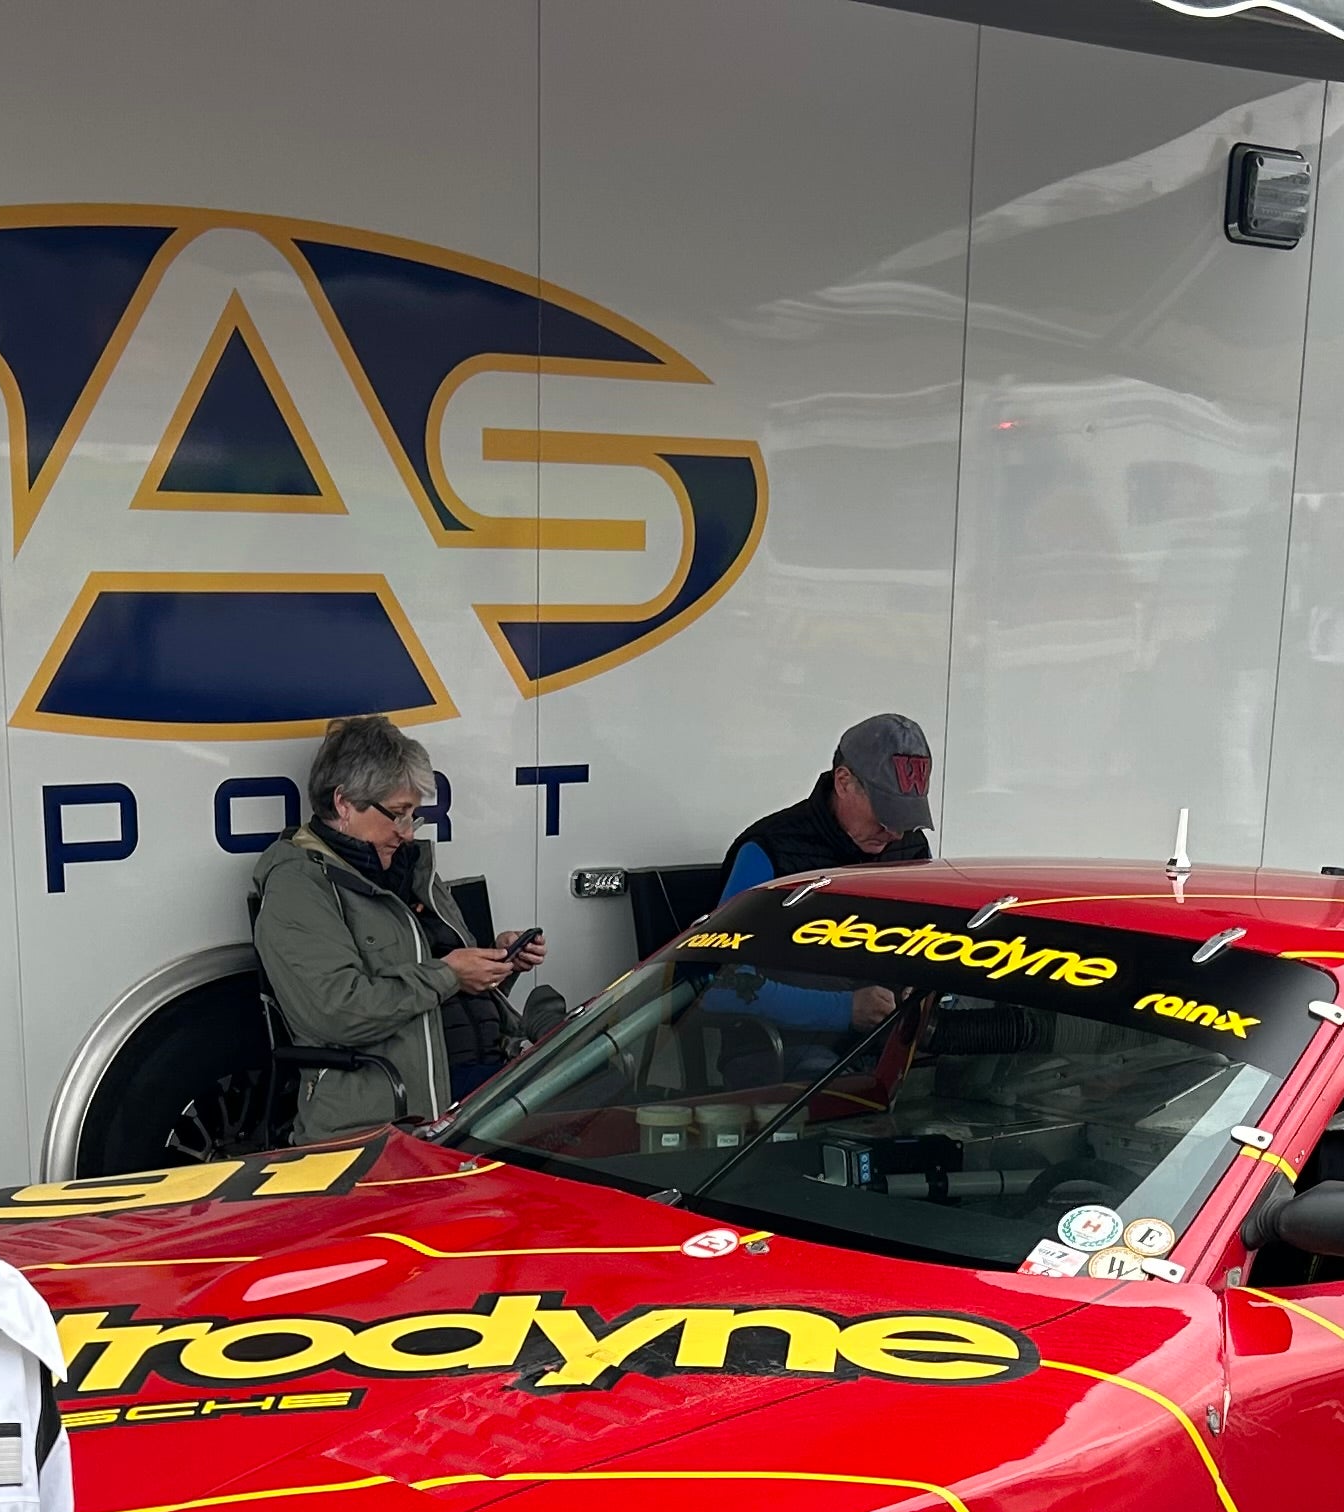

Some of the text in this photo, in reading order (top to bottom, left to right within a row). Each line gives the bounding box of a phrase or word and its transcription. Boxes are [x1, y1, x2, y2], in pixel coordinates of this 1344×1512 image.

[892, 755, 930, 797] W
[792, 915, 1118, 988] electrodyne
[689, 1234, 735, 1255] E
[53, 1294, 1015, 1391] trodyne
[60, 1391, 352, 1429] SCHE
